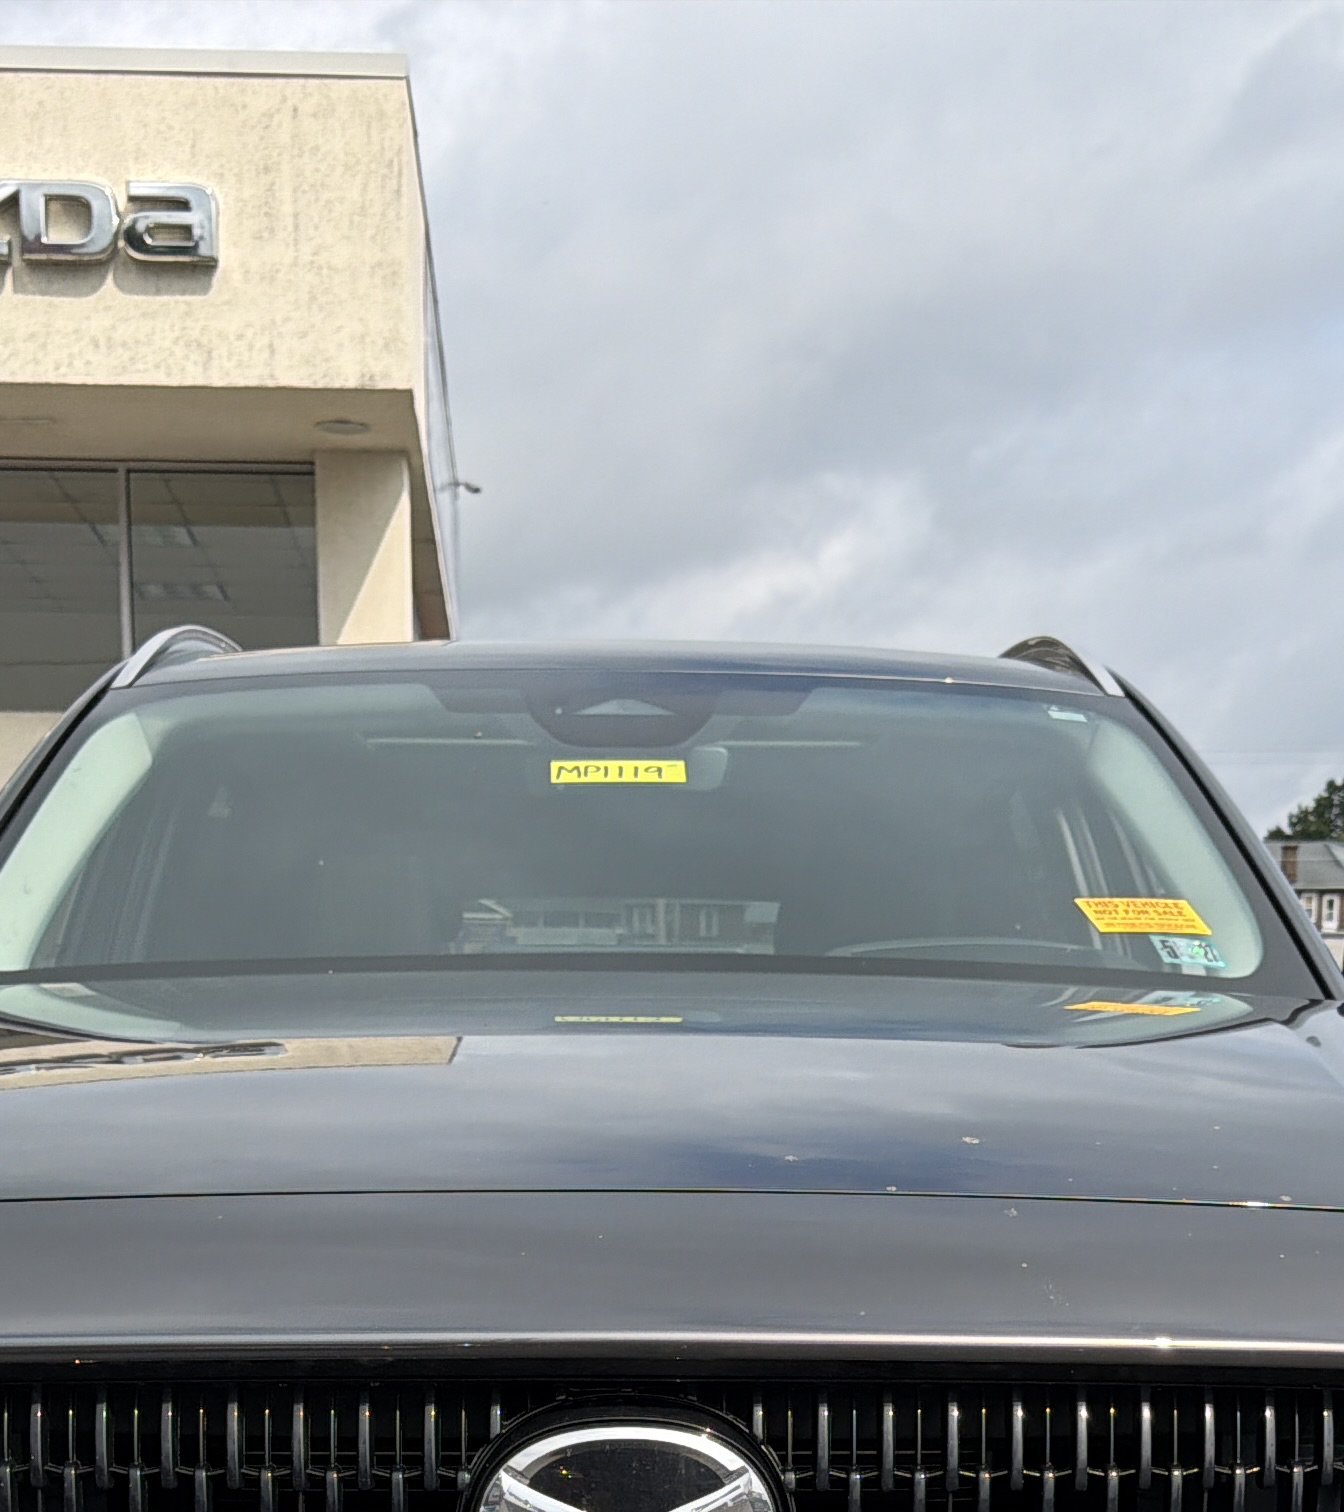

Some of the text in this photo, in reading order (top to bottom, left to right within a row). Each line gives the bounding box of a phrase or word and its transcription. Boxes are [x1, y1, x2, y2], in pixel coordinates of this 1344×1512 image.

[1084, 900, 1185, 910] THIS VEHICLE
[1093, 909, 1187, 918] NOT FOR SALE
